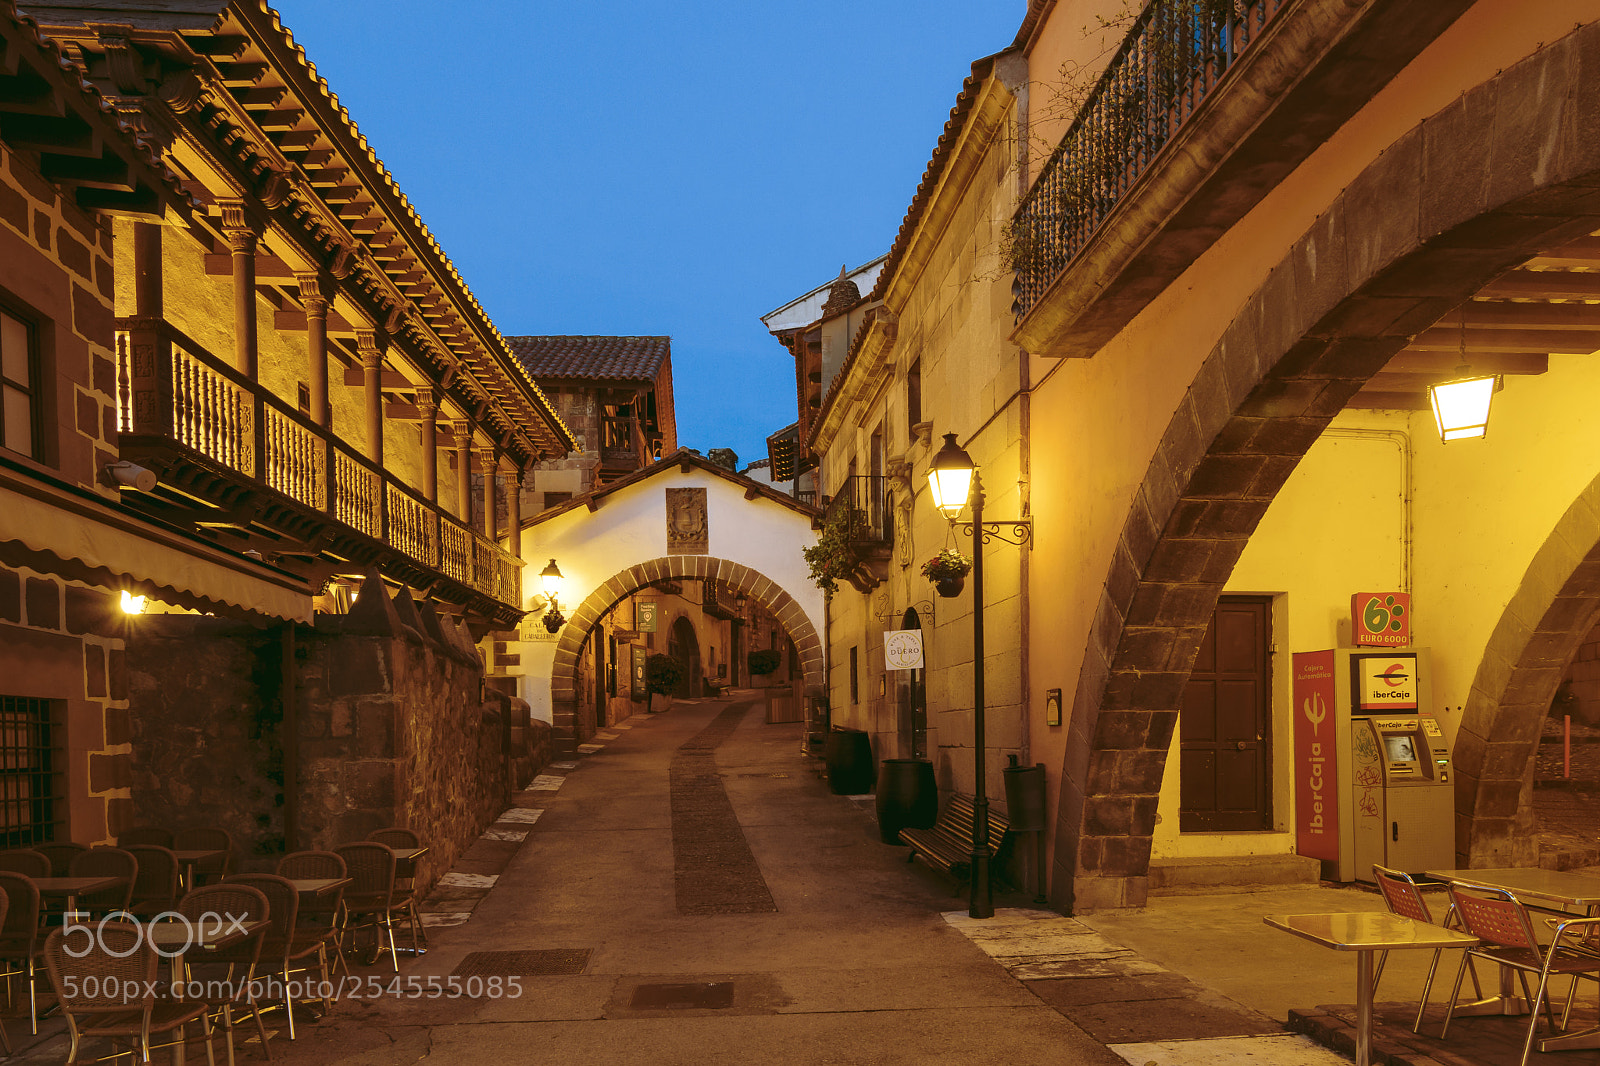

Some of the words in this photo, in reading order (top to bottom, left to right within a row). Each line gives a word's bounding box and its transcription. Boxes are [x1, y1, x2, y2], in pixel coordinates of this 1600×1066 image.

[1360, 634, 1383, 643] EURO
[1384, 635, 1407, 643] 6000
[1303, 665, 1324, 673] Cajero
[1373, 690, 1410, 700] iberCaja
[1308, 742, 1325, 835] iberCaja
